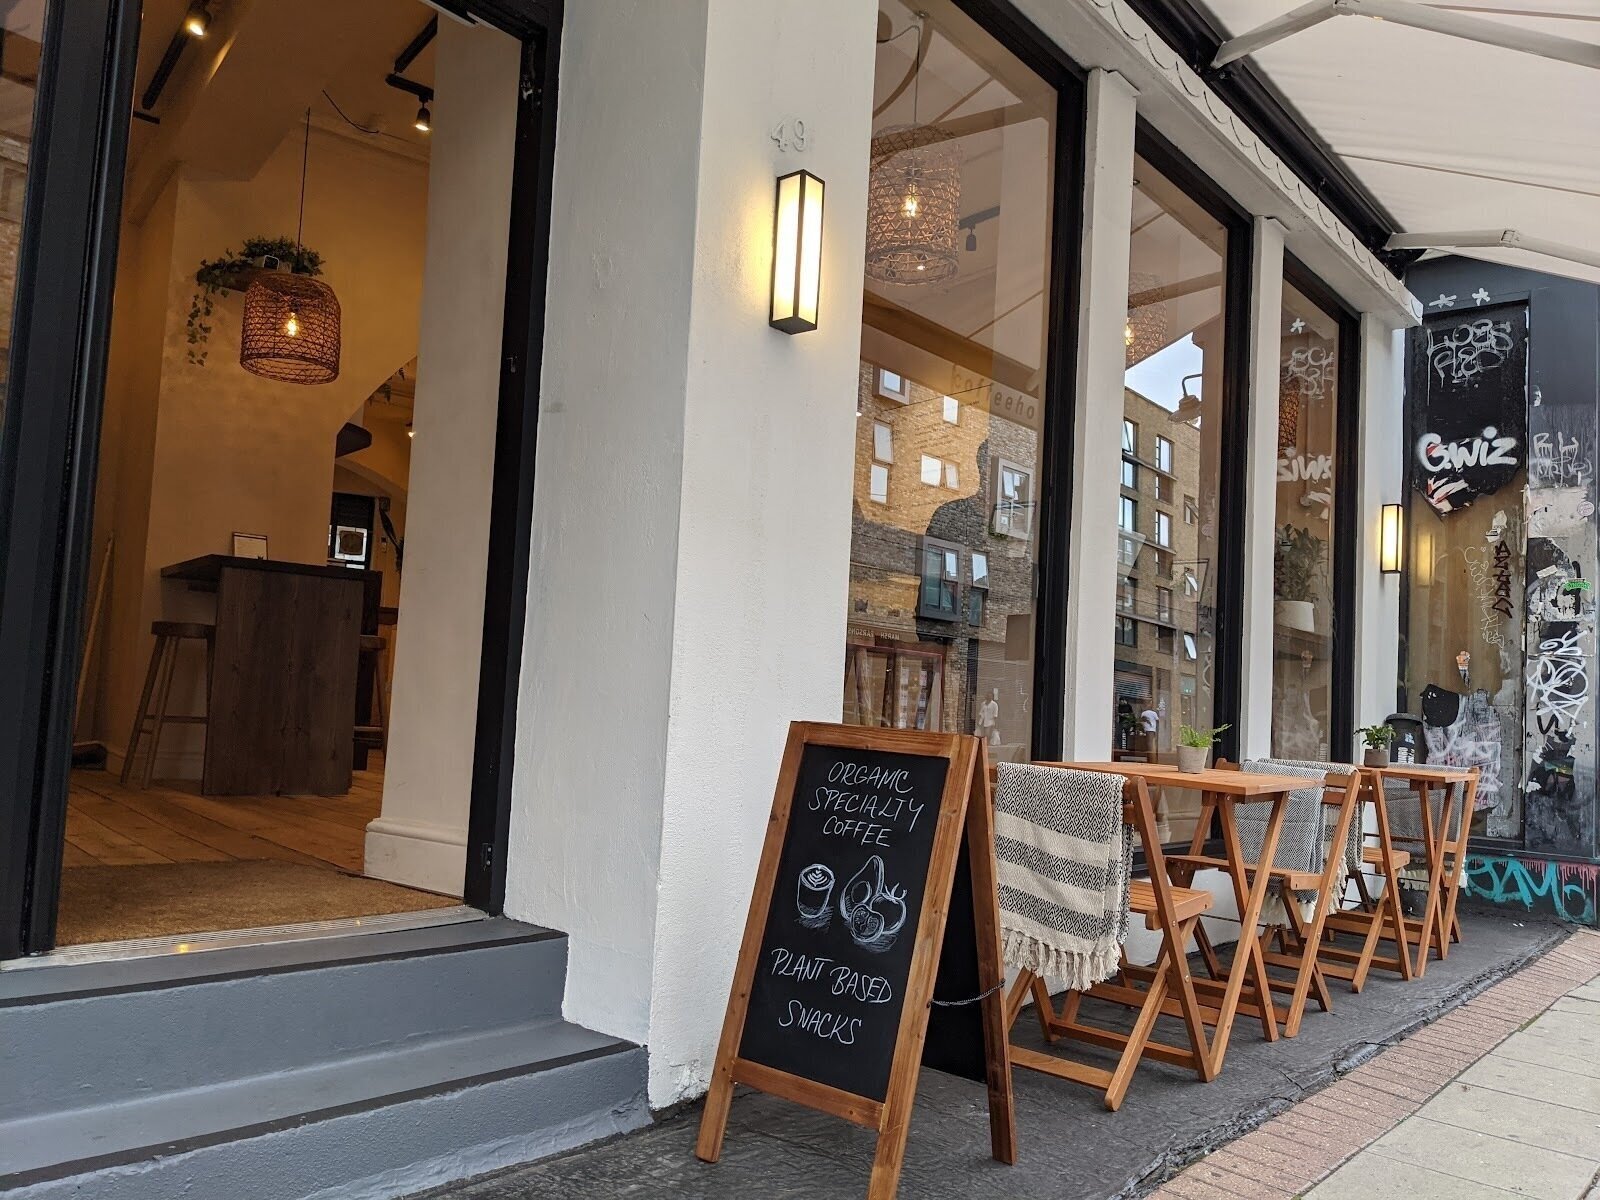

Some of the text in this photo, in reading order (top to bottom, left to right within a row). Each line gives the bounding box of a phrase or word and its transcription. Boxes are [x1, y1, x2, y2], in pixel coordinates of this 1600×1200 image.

[770, 118, 806, 152] 49
[828, 761, 914, 793] ORGANIC
[808, 786, 925, 832] SPECIALTY
[822, 815, 892, 847] COFFEE
[771, 948, 892, 1003] PLANT BASED
[778, 999, 862, 1044] SNACKS
